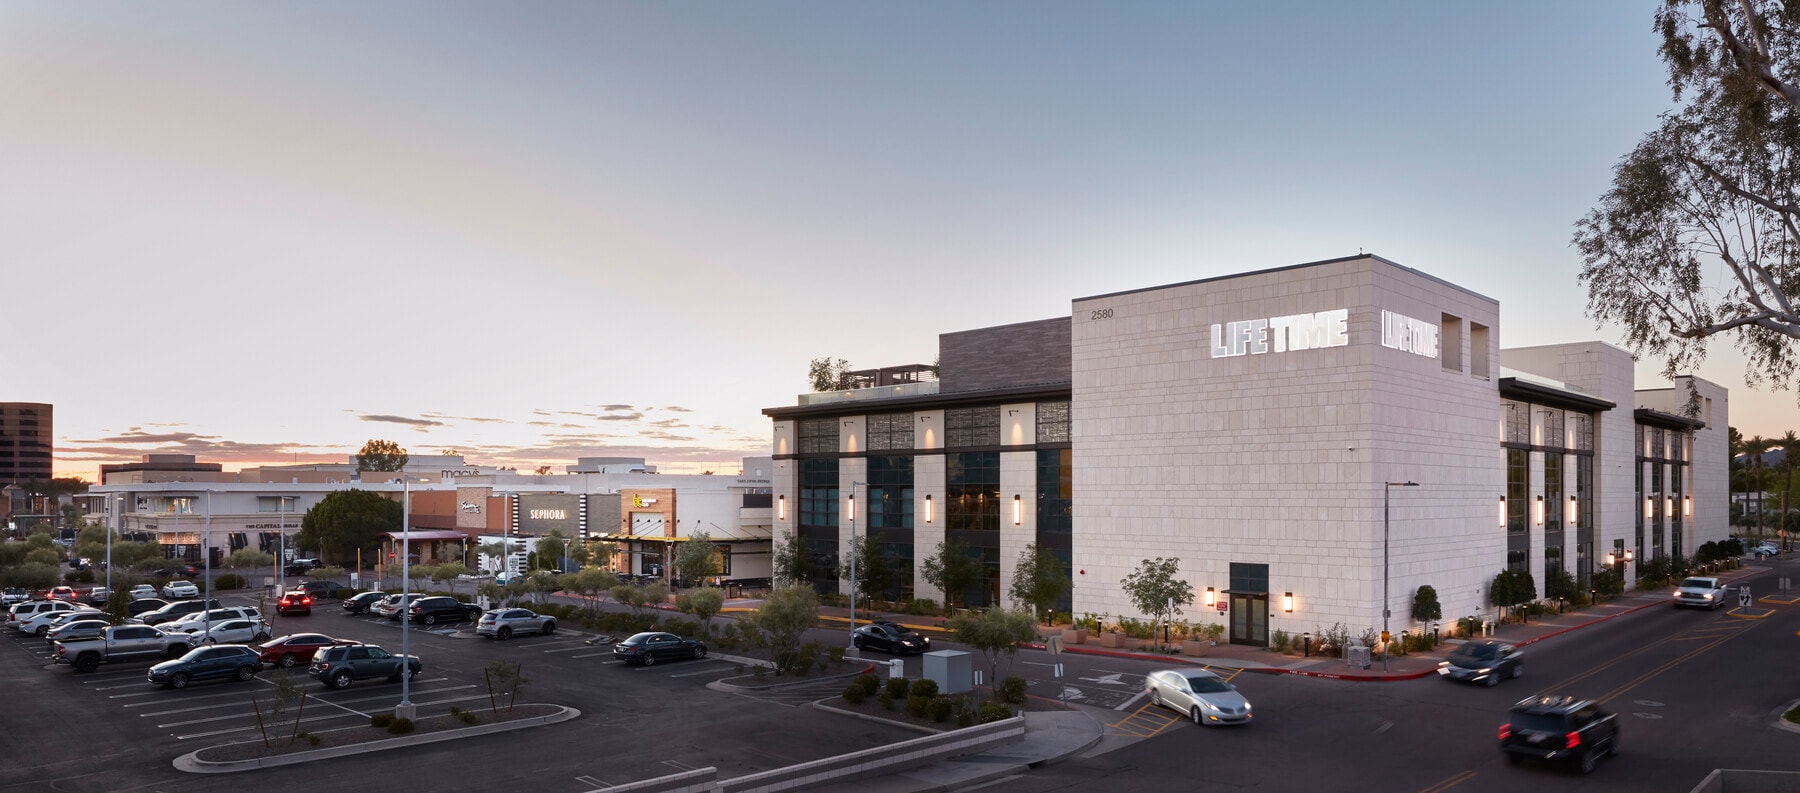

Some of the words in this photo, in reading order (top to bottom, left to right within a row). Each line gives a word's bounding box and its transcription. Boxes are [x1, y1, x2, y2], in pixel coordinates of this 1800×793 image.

[1091, 308, 1114, 320] 2580
[1210, 318, 1268, 359] LIFE
[1269, 308, 1349, 353] TIME
[1381, 309, 1410, 352] LIFE
[1407, 317, 1439, 359] TIME
[530, 509, 565, 519] SEPHORA
